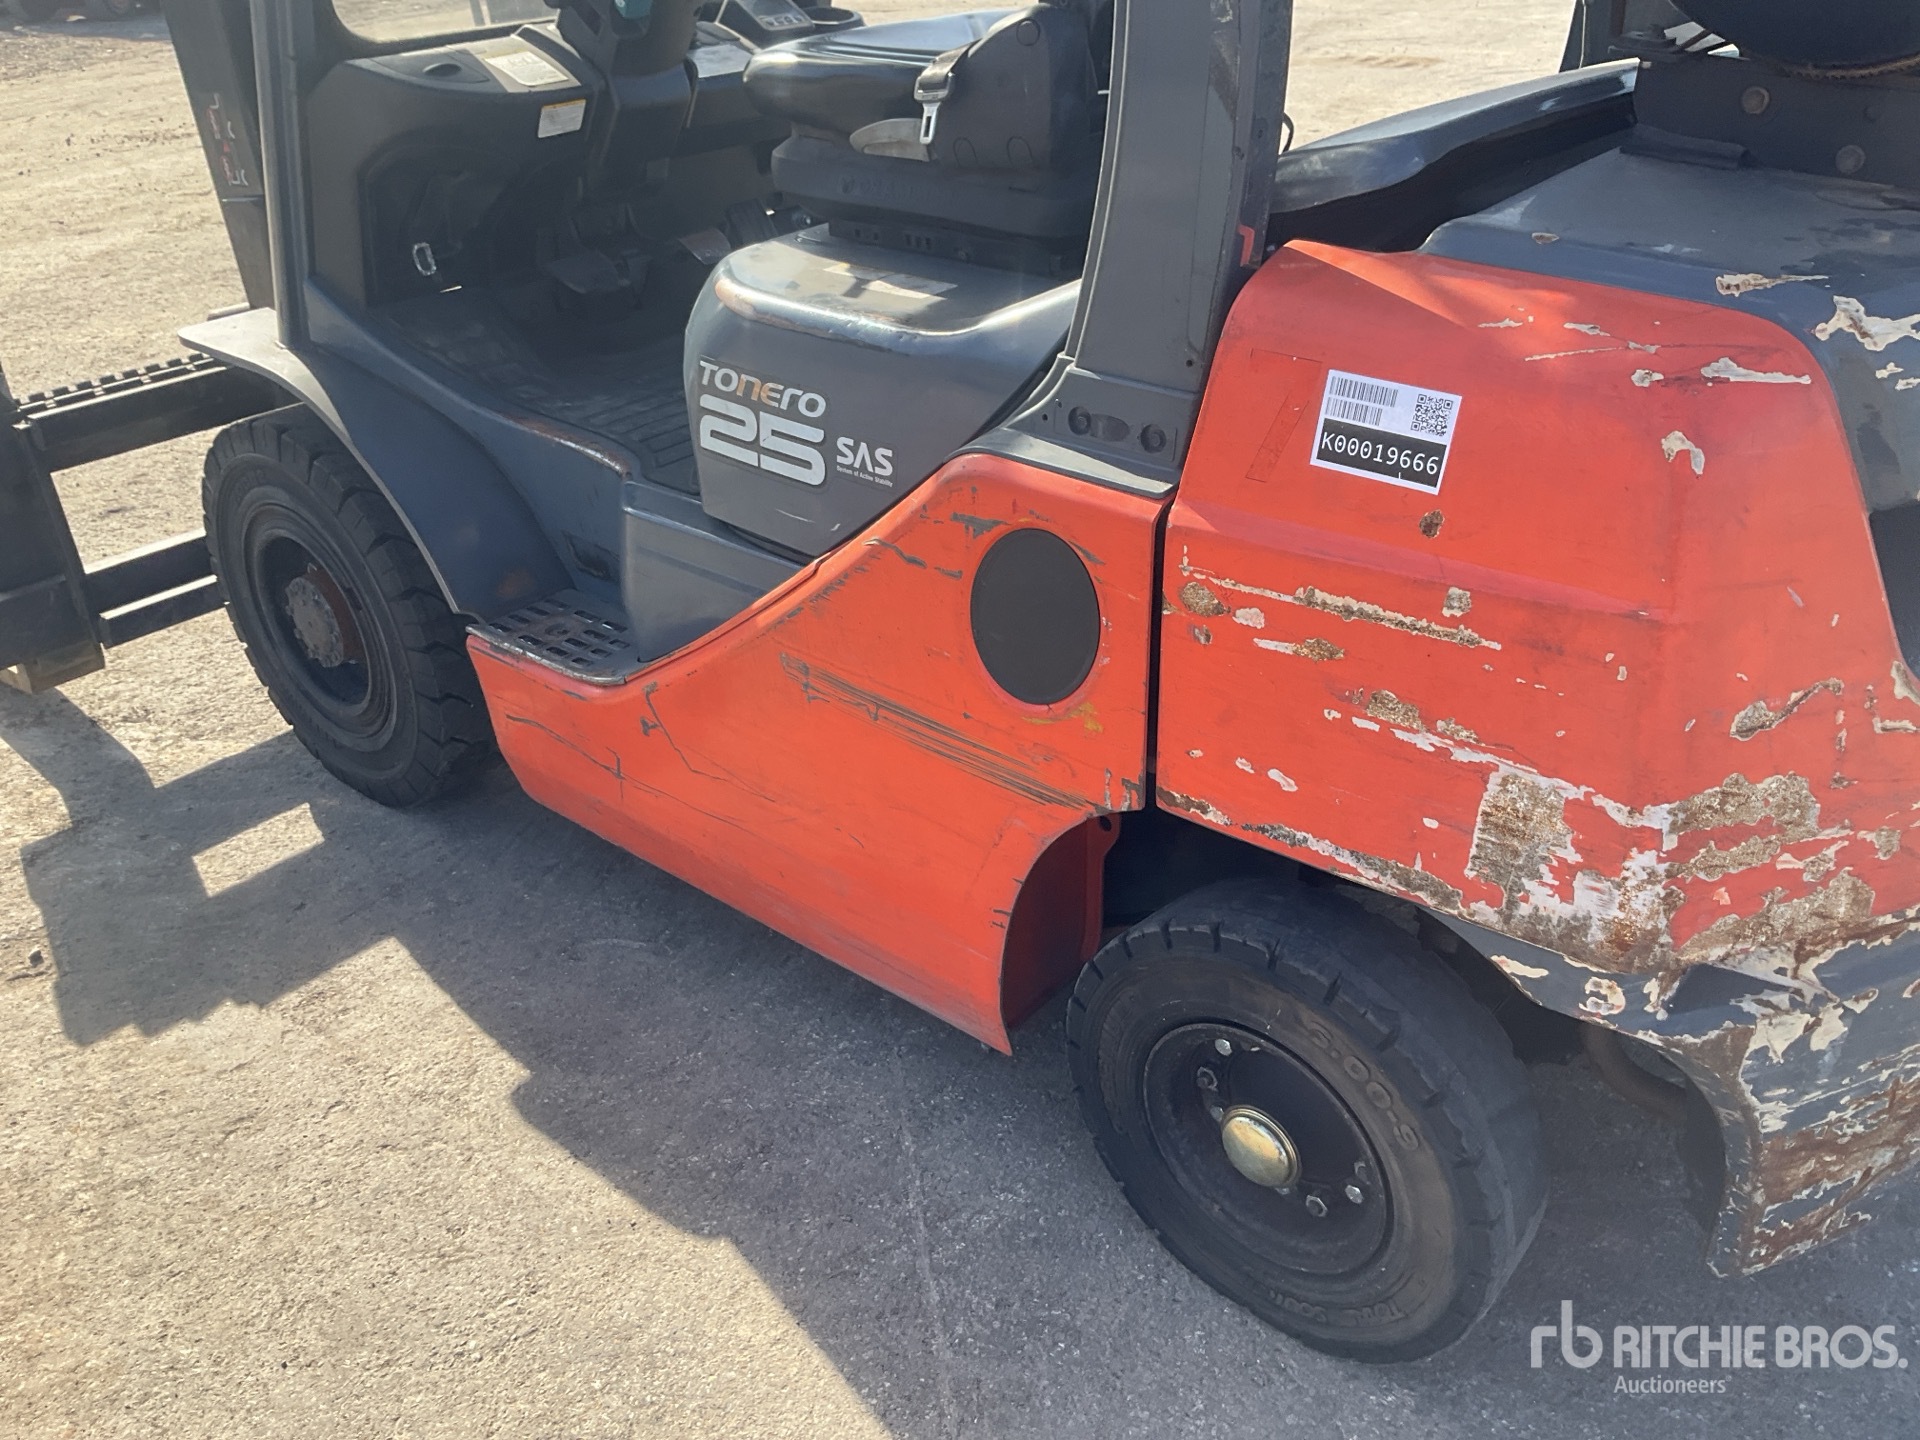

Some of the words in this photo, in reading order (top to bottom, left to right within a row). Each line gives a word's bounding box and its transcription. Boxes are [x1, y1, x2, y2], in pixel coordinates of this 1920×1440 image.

[700, 393, 826, 486] 25
[836, 436, 893, 476] SAS
[1321, 431, 1440, 475] K00019666
